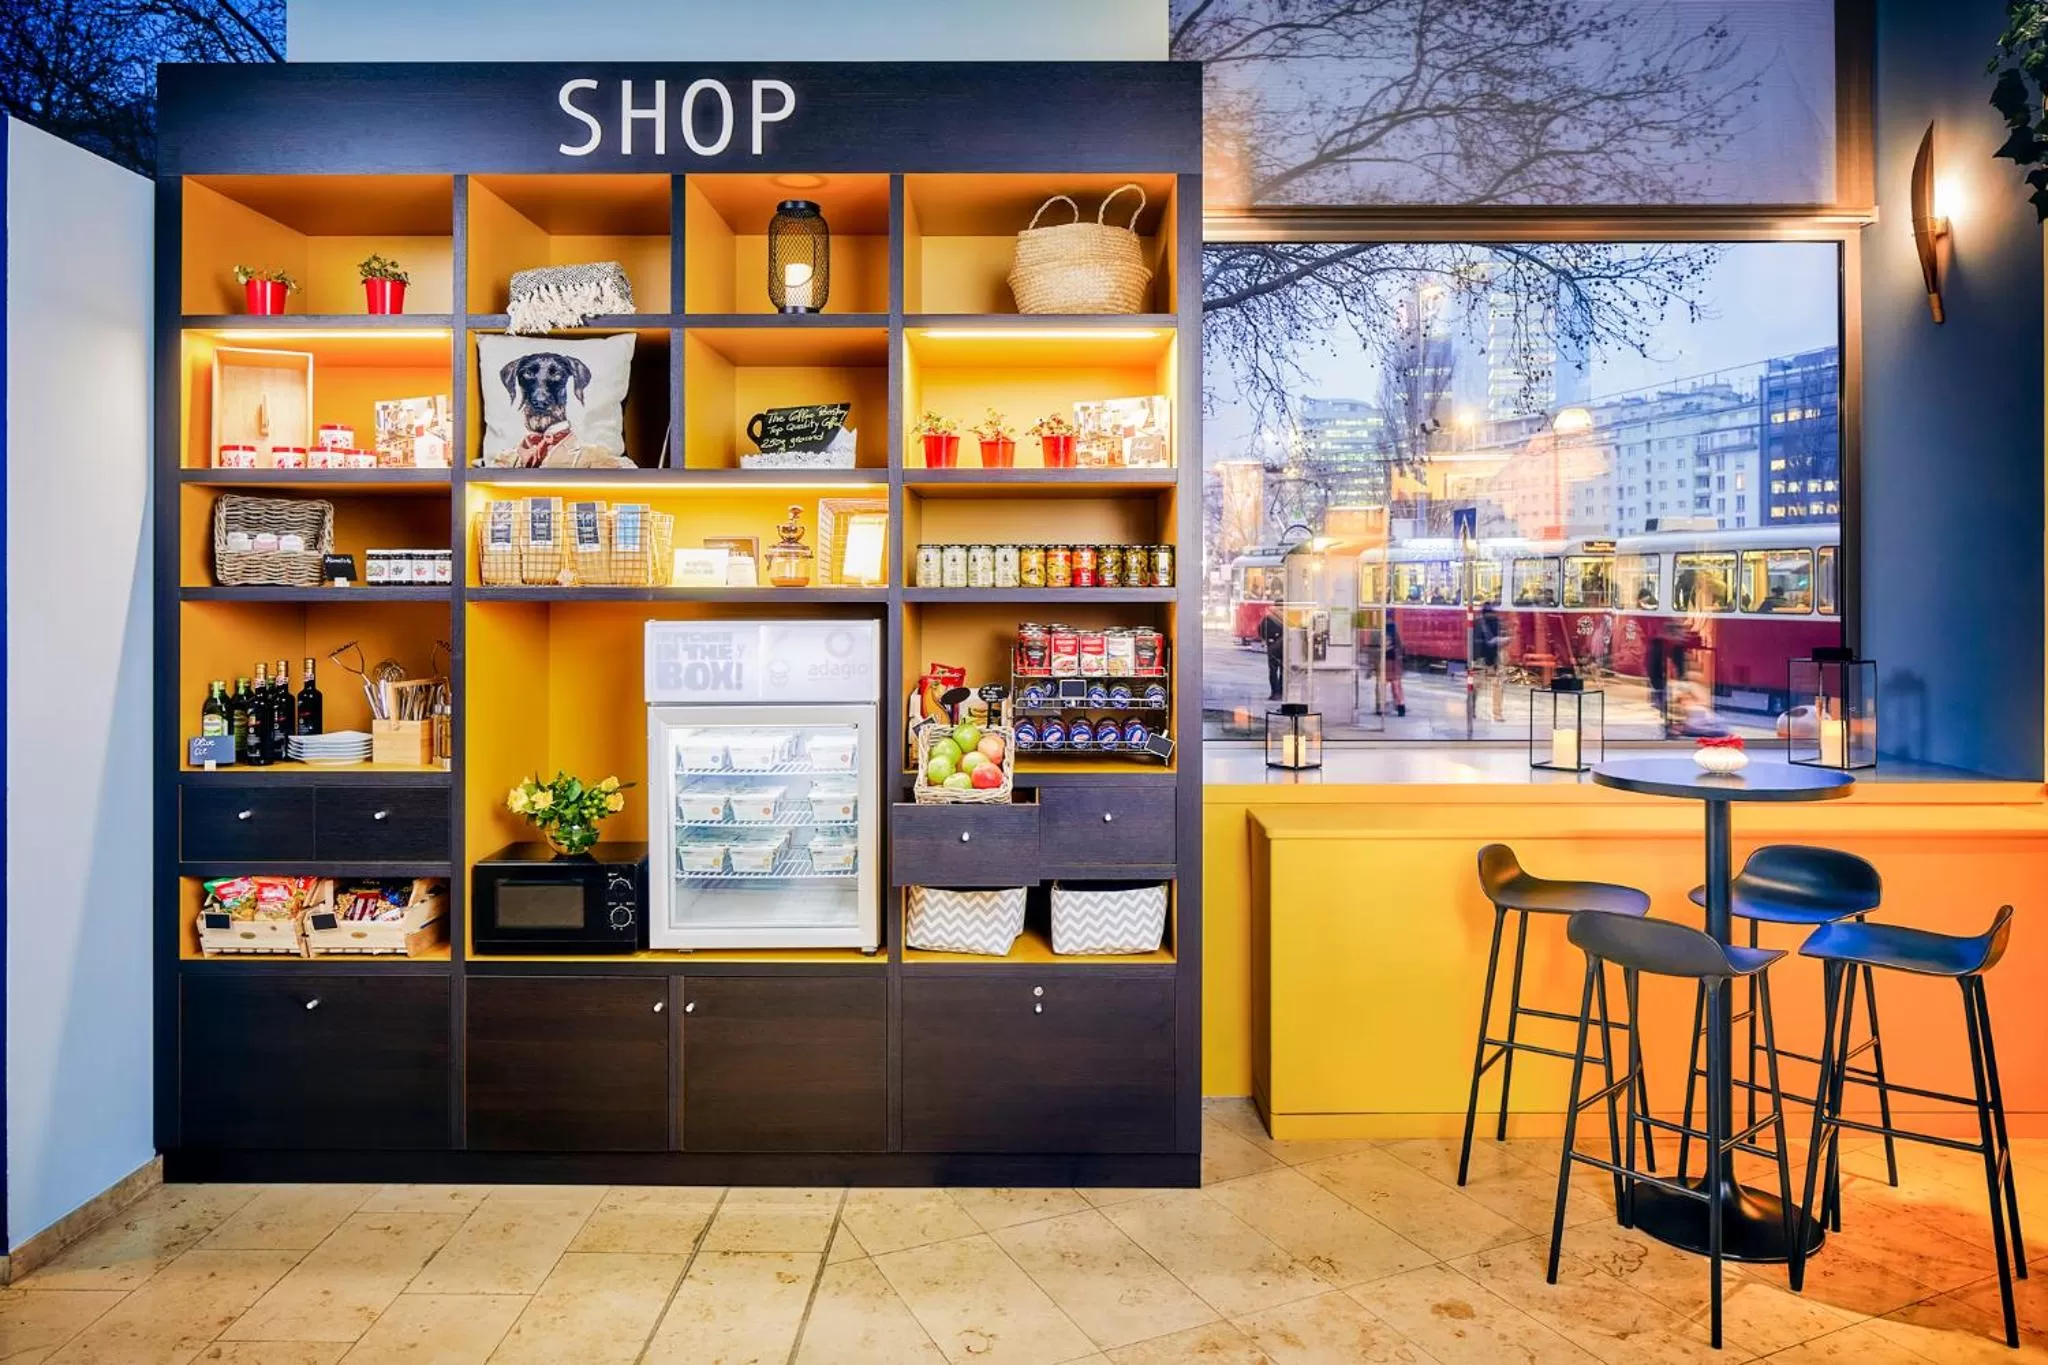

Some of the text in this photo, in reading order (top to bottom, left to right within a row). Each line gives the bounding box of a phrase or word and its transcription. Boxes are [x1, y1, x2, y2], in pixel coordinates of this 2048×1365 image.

[558, 78, 796, 157] SHOP
[767, 413, 785, 424] The
[788, 408, 815, 423] Coffee
[767, 425, 784, 437] Top
[786, 419, 819, 435] Quality
[789, 431, 825, 449] ground
[655, 643, 732, 660] IN THE
[656, 661, 743, 690] BOX!
[807, 658, 869, 680] adagio
